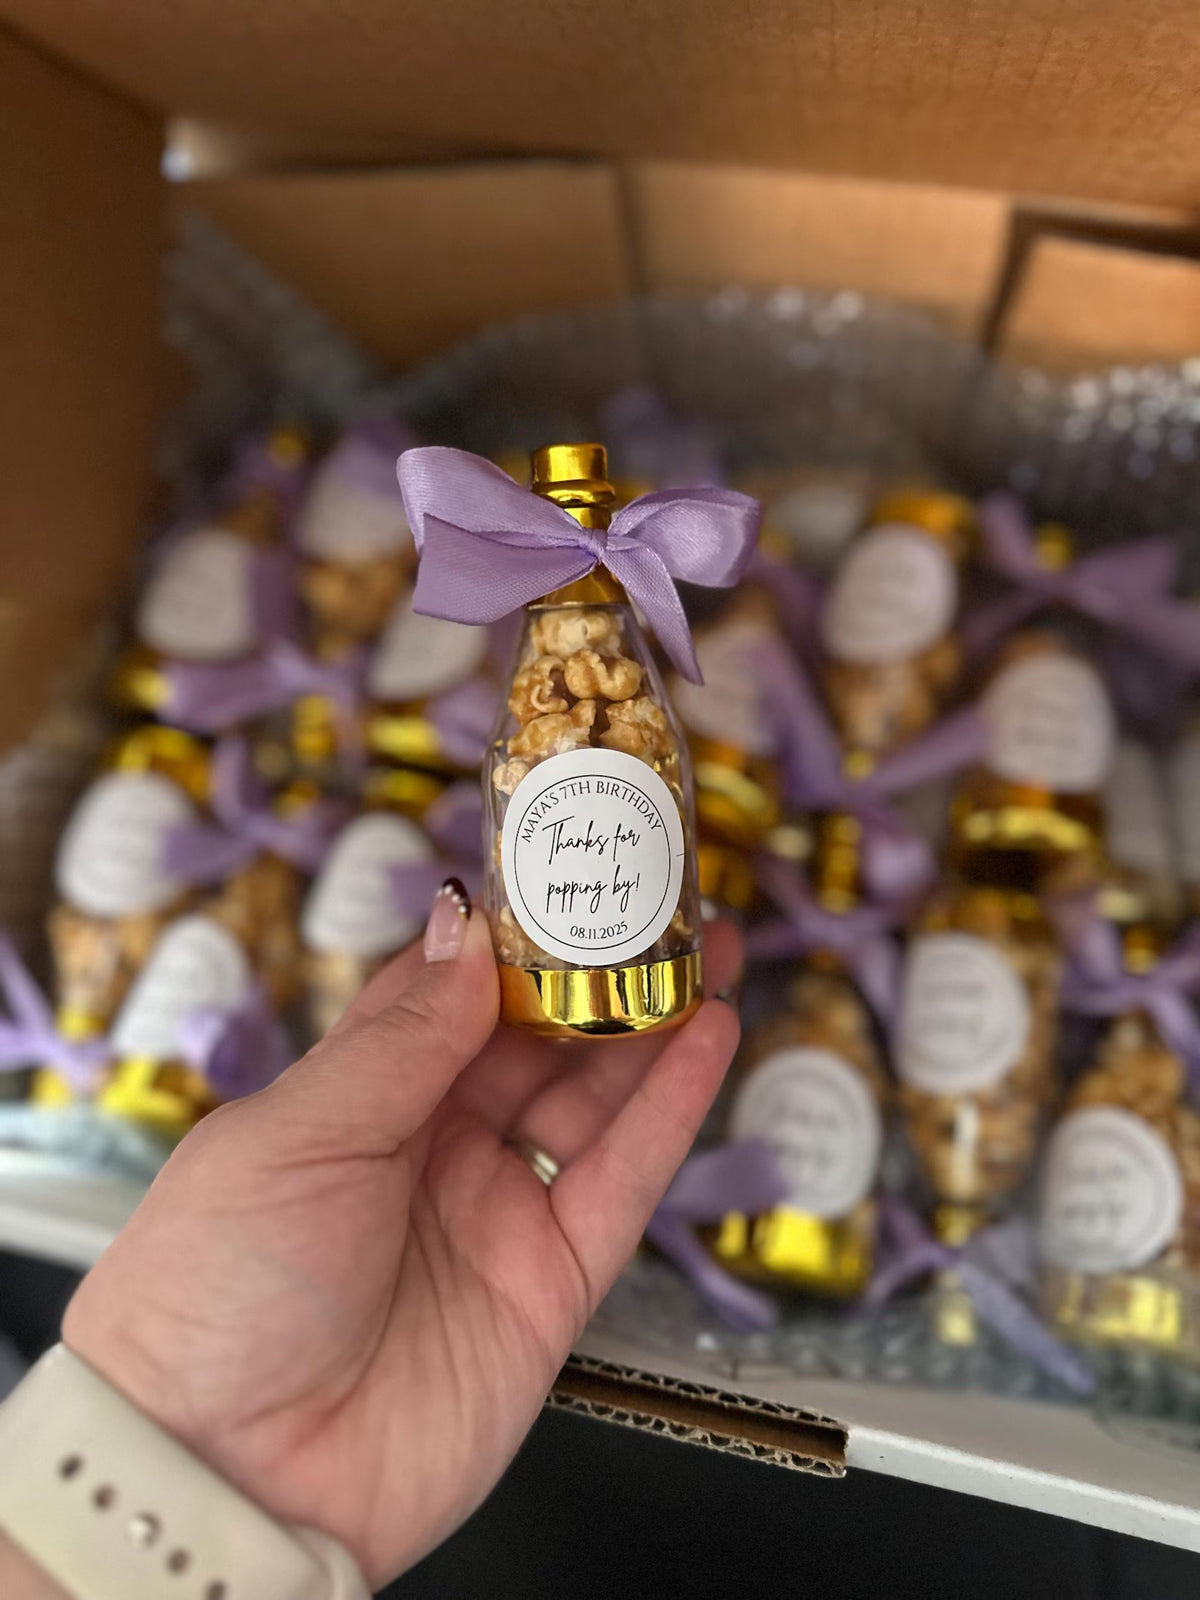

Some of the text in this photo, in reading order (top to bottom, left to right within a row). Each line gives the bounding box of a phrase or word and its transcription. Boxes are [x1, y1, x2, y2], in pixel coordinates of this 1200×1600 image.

[521, 781, 662, 843] MAYA'S 7TH BIRTHDAY
[542, 815, 641, 865] Thanks for
[546, 864, 641, 914] popping by!
[569, 920, 628, 940] 08.11.2025
